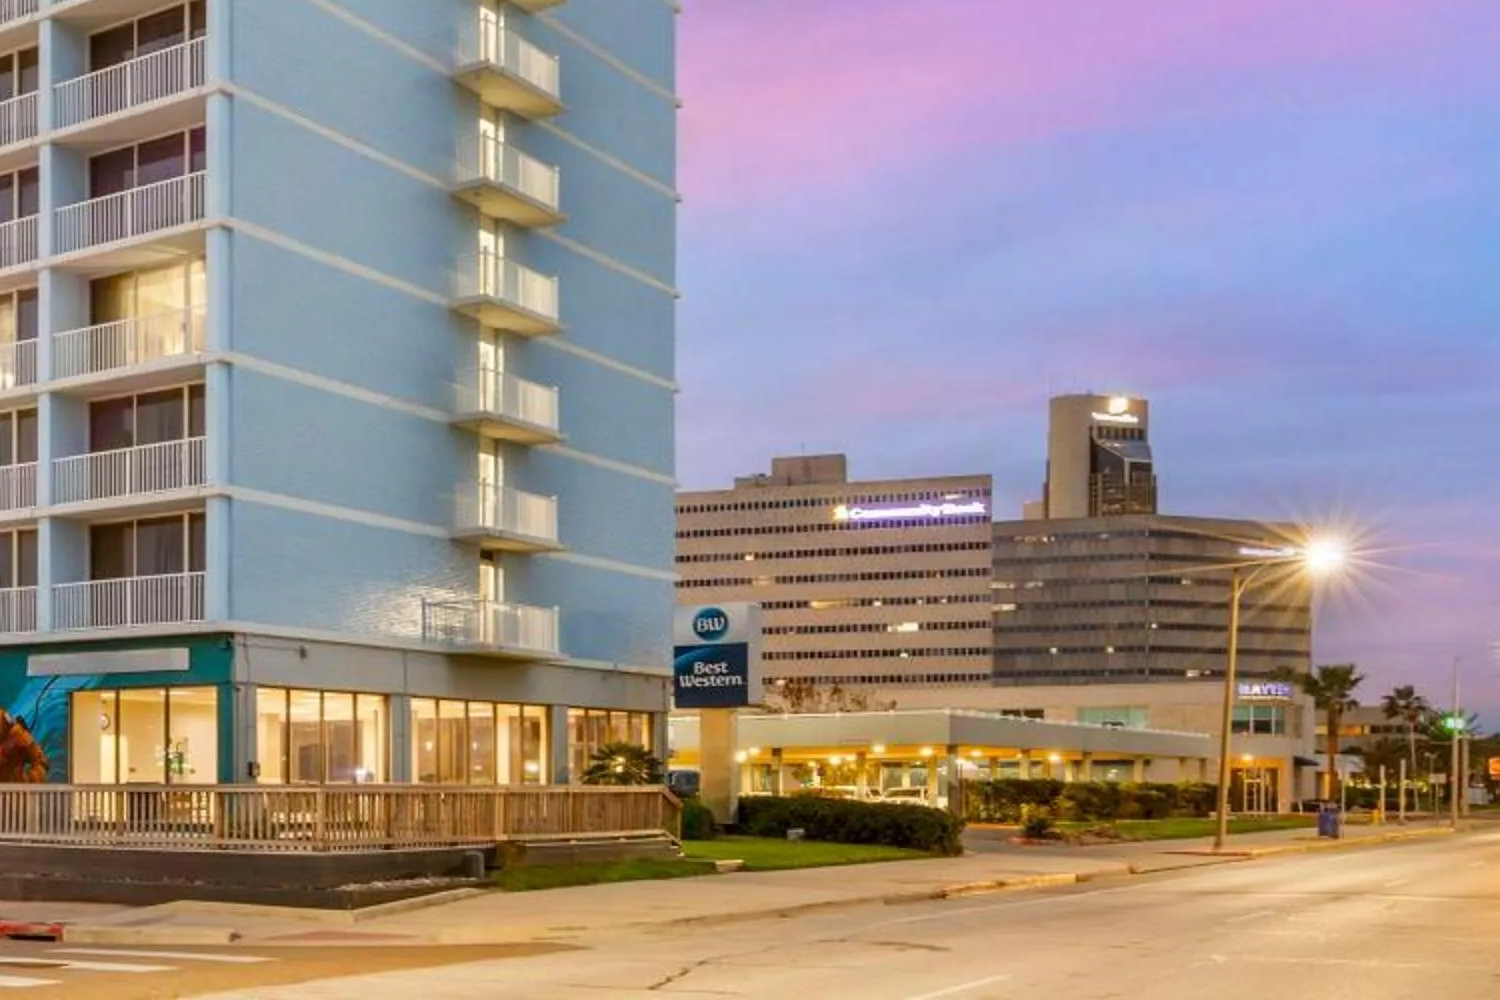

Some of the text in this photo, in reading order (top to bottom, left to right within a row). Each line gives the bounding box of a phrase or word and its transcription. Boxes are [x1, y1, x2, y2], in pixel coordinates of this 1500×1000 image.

[697, 618, 725, 633] BW
[694, 661, 728, 675] Best
[679, 675, 742, 688] Western
